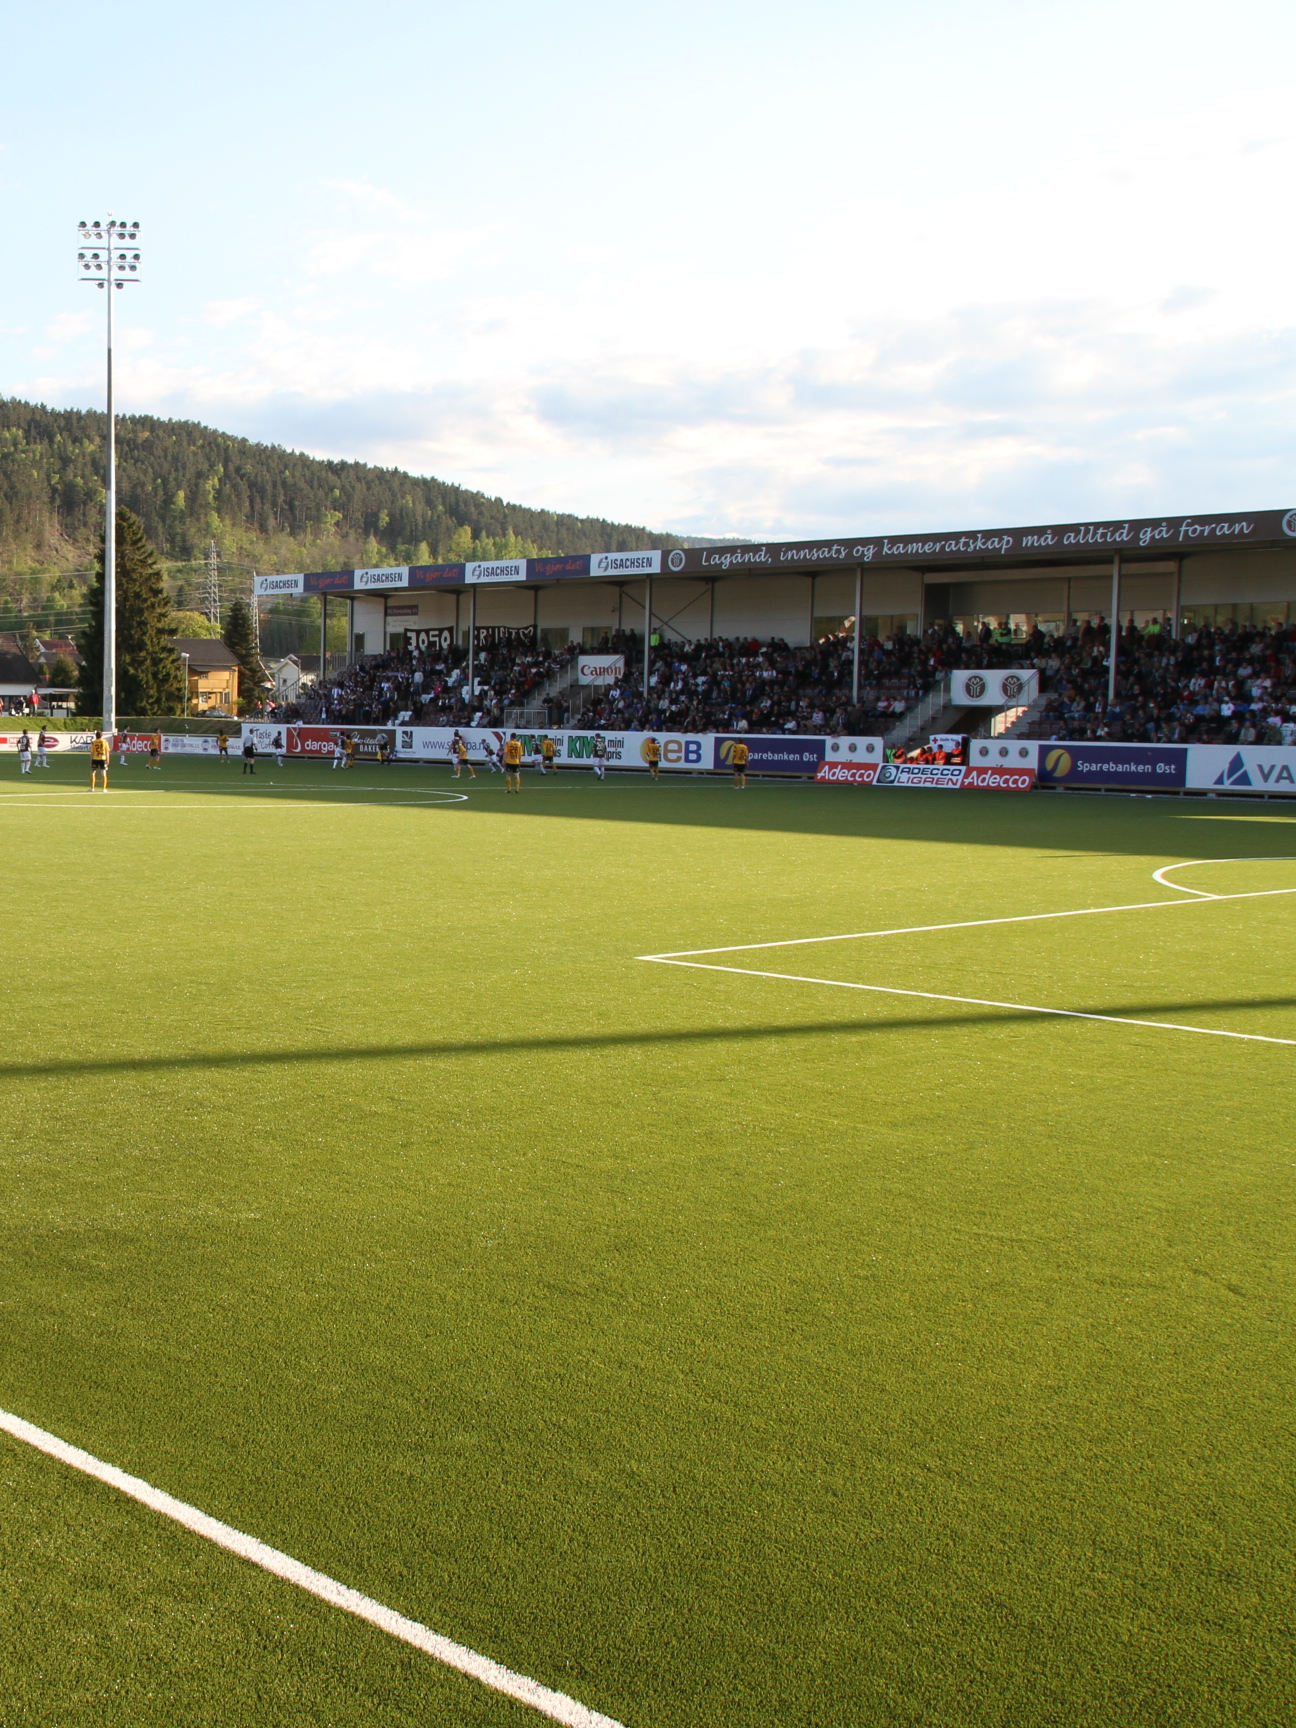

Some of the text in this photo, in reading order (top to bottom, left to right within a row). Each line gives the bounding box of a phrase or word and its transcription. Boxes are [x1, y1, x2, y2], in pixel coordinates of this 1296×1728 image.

[701, 519, 1256, 570] Lagånd, innsats og kameratskap må alltid gå foran
[610, 556, 653, 570] ISACHSEN
[482, 565, 520, 577] ISACHSEN
[268, 578, 299, 590] ISACHSEN
[369, 572, 403, 585] ISACHSEN
[580, 663, 622, 678] Canon
[509, 745, 519, 754] 26
[607, 737, 625, 749] mini
[748, 750, 818, 762] parebanken Øst
[817, 764, 875, 782] Adecco
[899, 766, 963, 778] ADECCO
[1077, 760, 1177, 774] Sparebanken Øst
[963, 769, 1030, 789] Adecco
